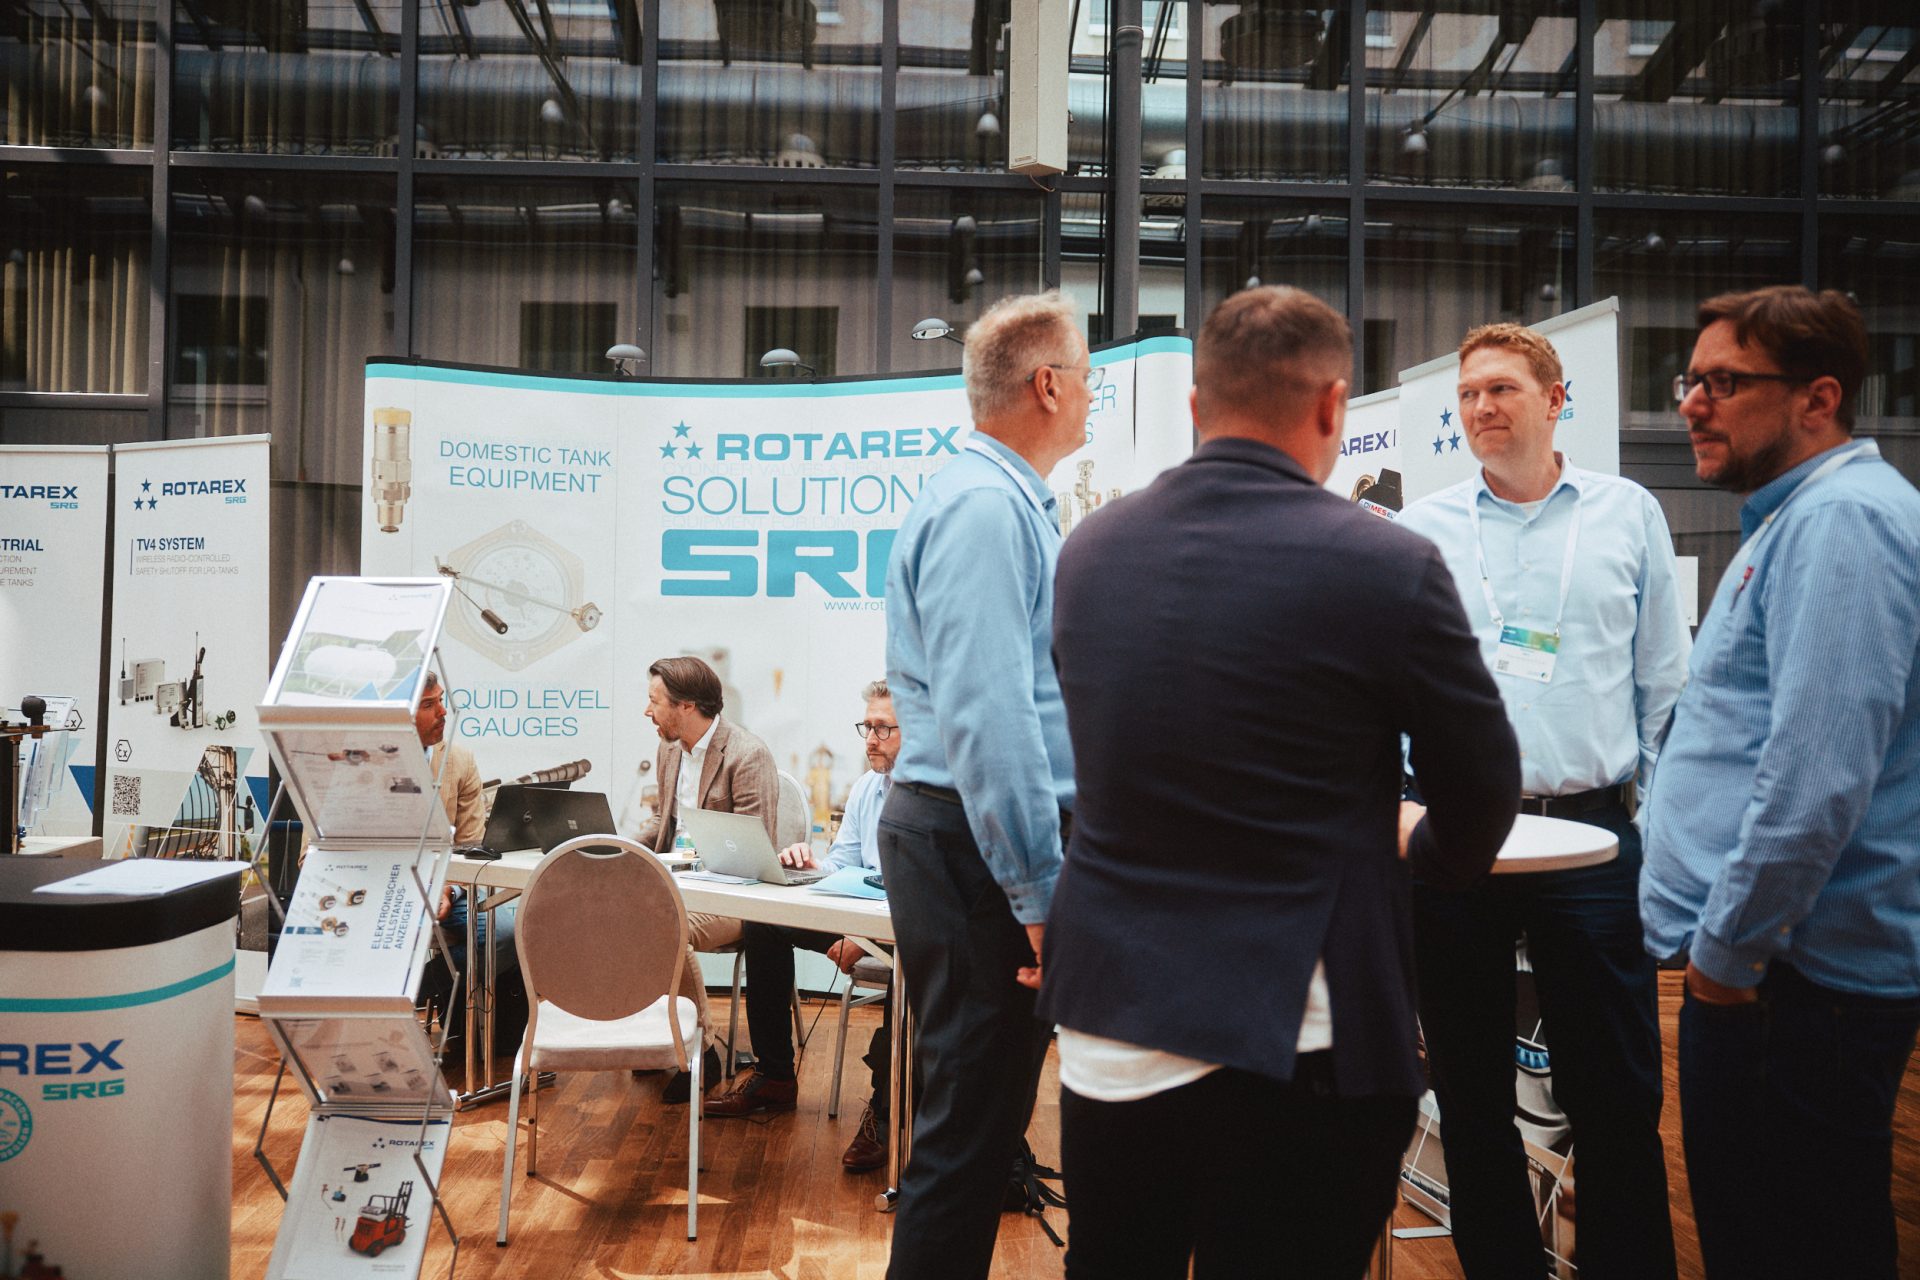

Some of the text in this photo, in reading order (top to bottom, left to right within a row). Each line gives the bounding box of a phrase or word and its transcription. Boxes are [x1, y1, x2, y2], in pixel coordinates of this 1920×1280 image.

[440, 440, 552, 464] DOMESTIC
[558, 448, 612, 467] TANK
[717, 427, 960, 461] ROTAREX
[162, 478, 246, 497] ROTAREX
[450, 466, 602, 493] EQUIPMENT
[0, 485, 78, 499] TAREX
[225, 496, 247, 504] SRG
[661, 473, 936, 516] SOLUTION
[50, 502, 79, 510] SRG
[0, 538, 44, 551] TRIAL
[137, 537, 205, 551] TV4 SYSTEM
[0, 555, 22, 563] TION
[660, 529, 897, 598] SR
[8, 579, 33, 587] TANKS
[445, 688, 610, 710] IQUID LEVEL
[460, 716, 579, 738] GAUGES
[371, 864, 401, 950] ELEKTRONISCHER
[394, 900, 414, 950] ANZEIGER
[0, 1039, 124, 1075] REX
[42, 1079, 125, 1101] SRG
